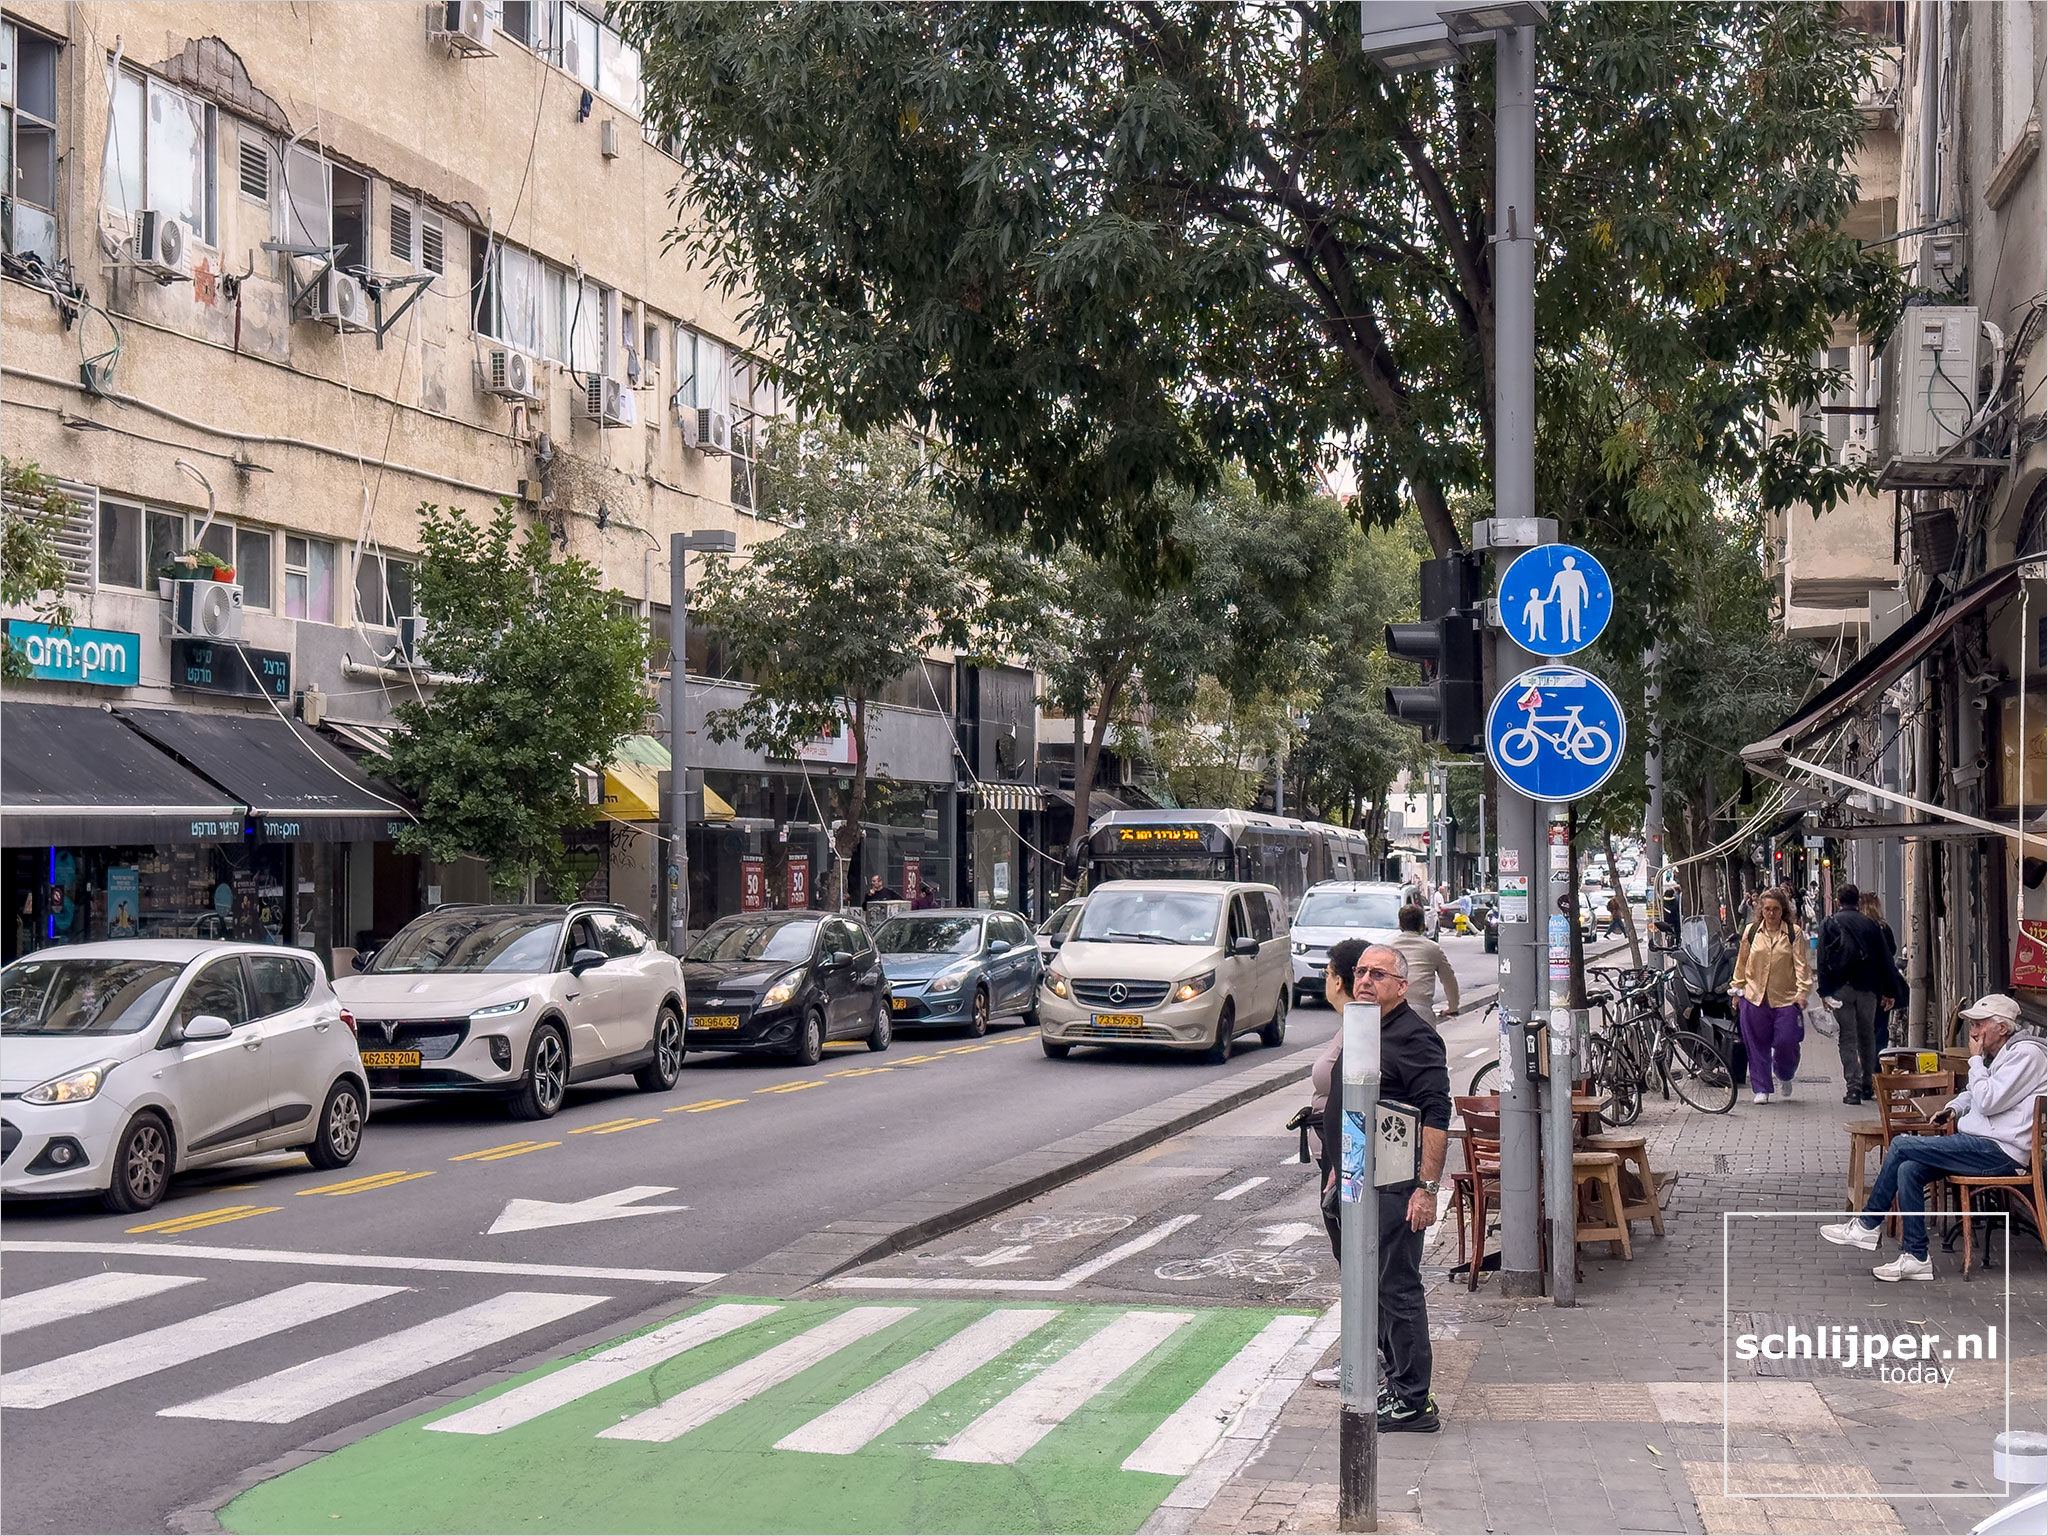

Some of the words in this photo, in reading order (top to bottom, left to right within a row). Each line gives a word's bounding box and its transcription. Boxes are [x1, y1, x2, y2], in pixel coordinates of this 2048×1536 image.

[26, 635, 126, 678] am:pm
[193, 647, 213, 664] סיטי
[187, 666, 212, 685] מרקט
[262, 657, 286, 676] הרצל
[276, 678, 286, 693] 61
[191, 821, 217, 838] מרקט
[218, 821, 240, 836] סיטי
[747, 874, 759, 895] 50
[793, 872, 804, 892] 50
